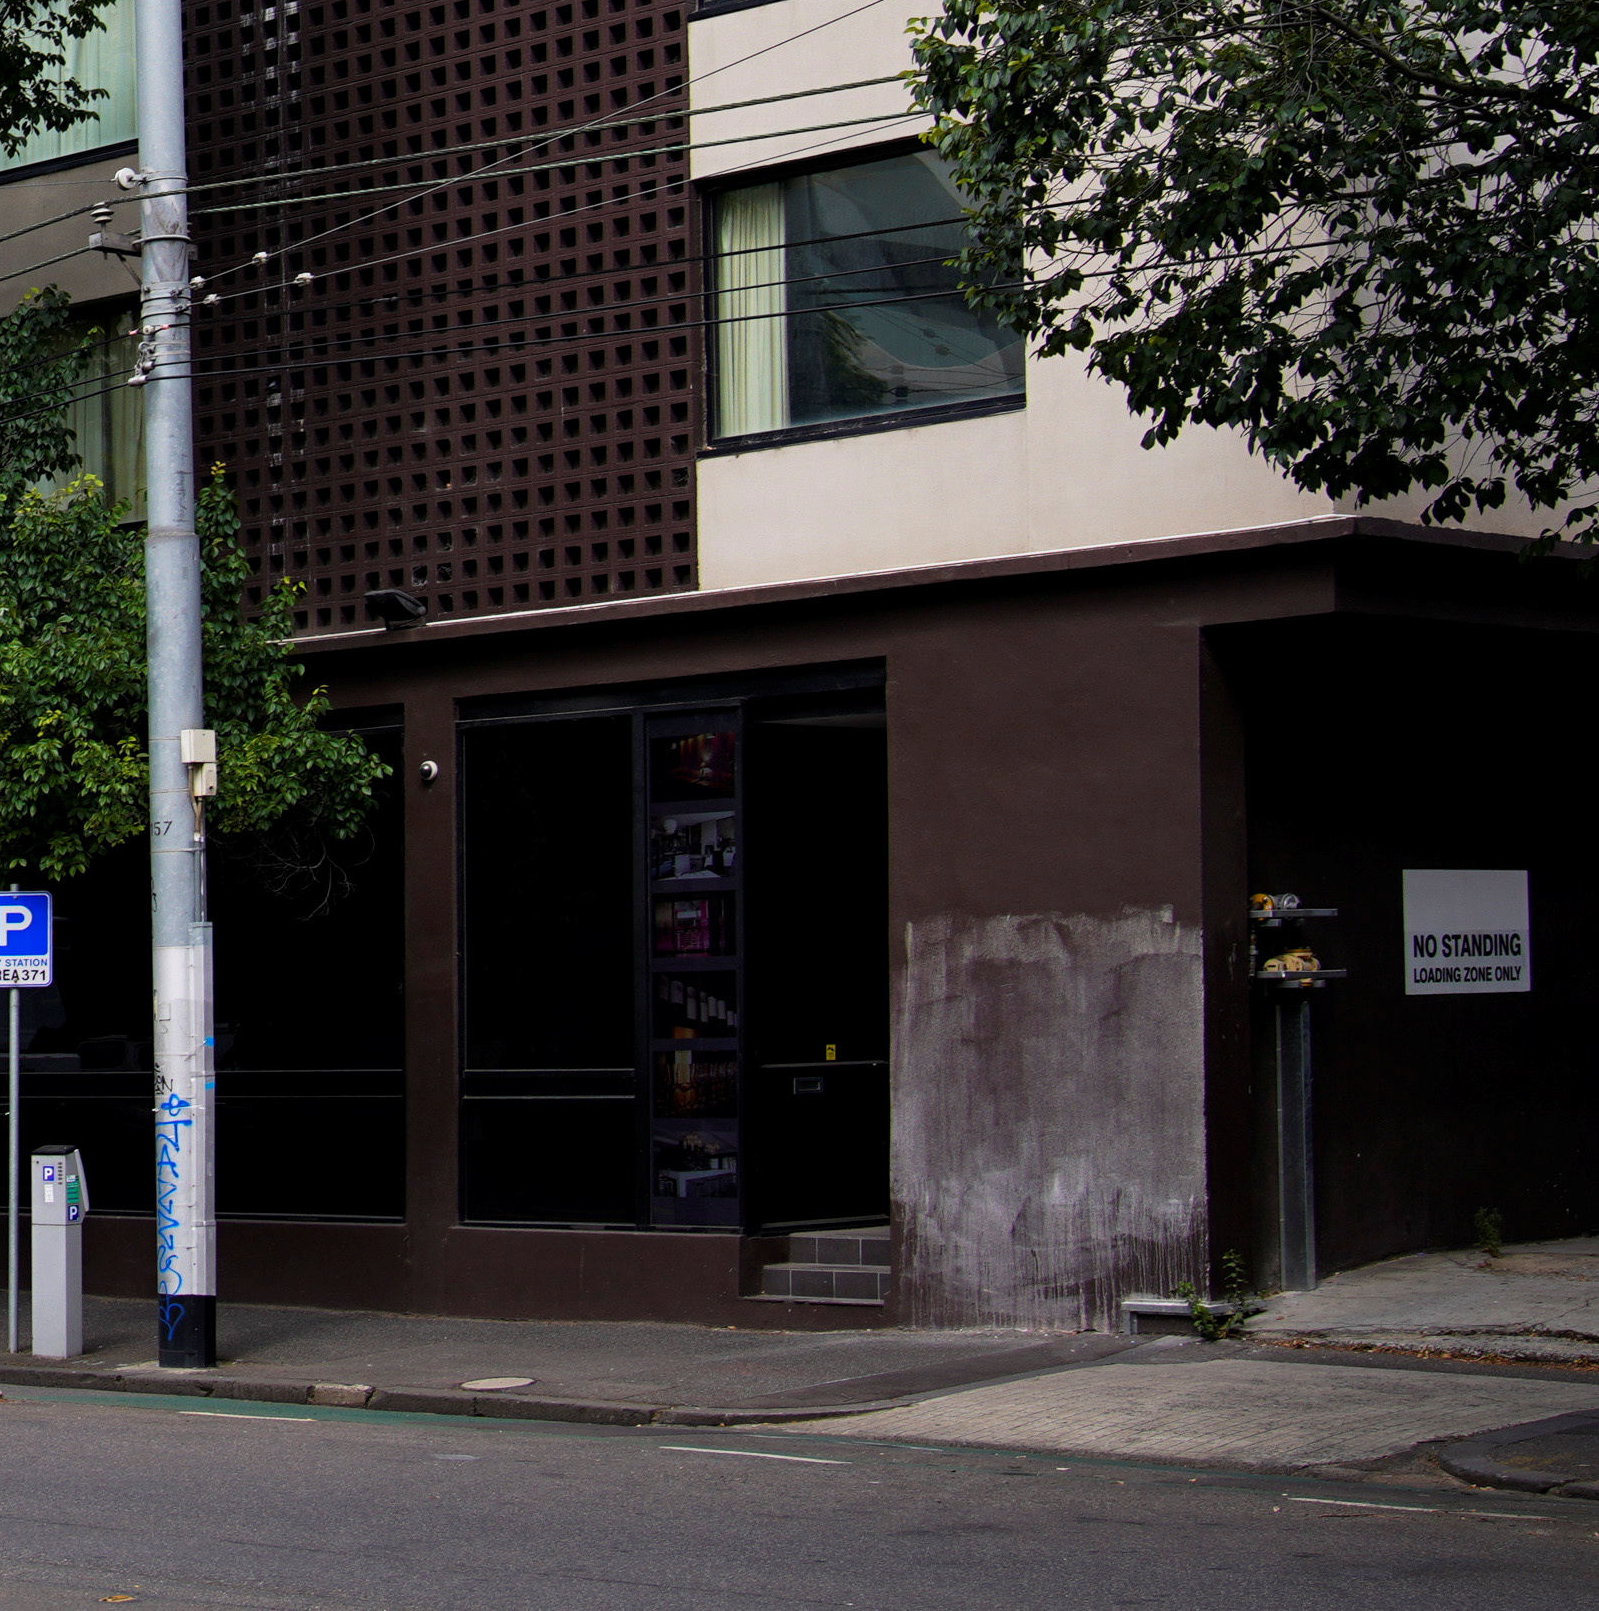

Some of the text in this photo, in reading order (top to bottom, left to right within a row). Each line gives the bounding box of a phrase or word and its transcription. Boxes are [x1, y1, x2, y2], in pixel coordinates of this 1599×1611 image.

[1414, 934, 1521, 958] NO STANDING
[5, 958, 48, 968] STATION
[22, 970, 46, 982] 371
[1414, 966, 1522, 984] LOADING ZONE ONLY
